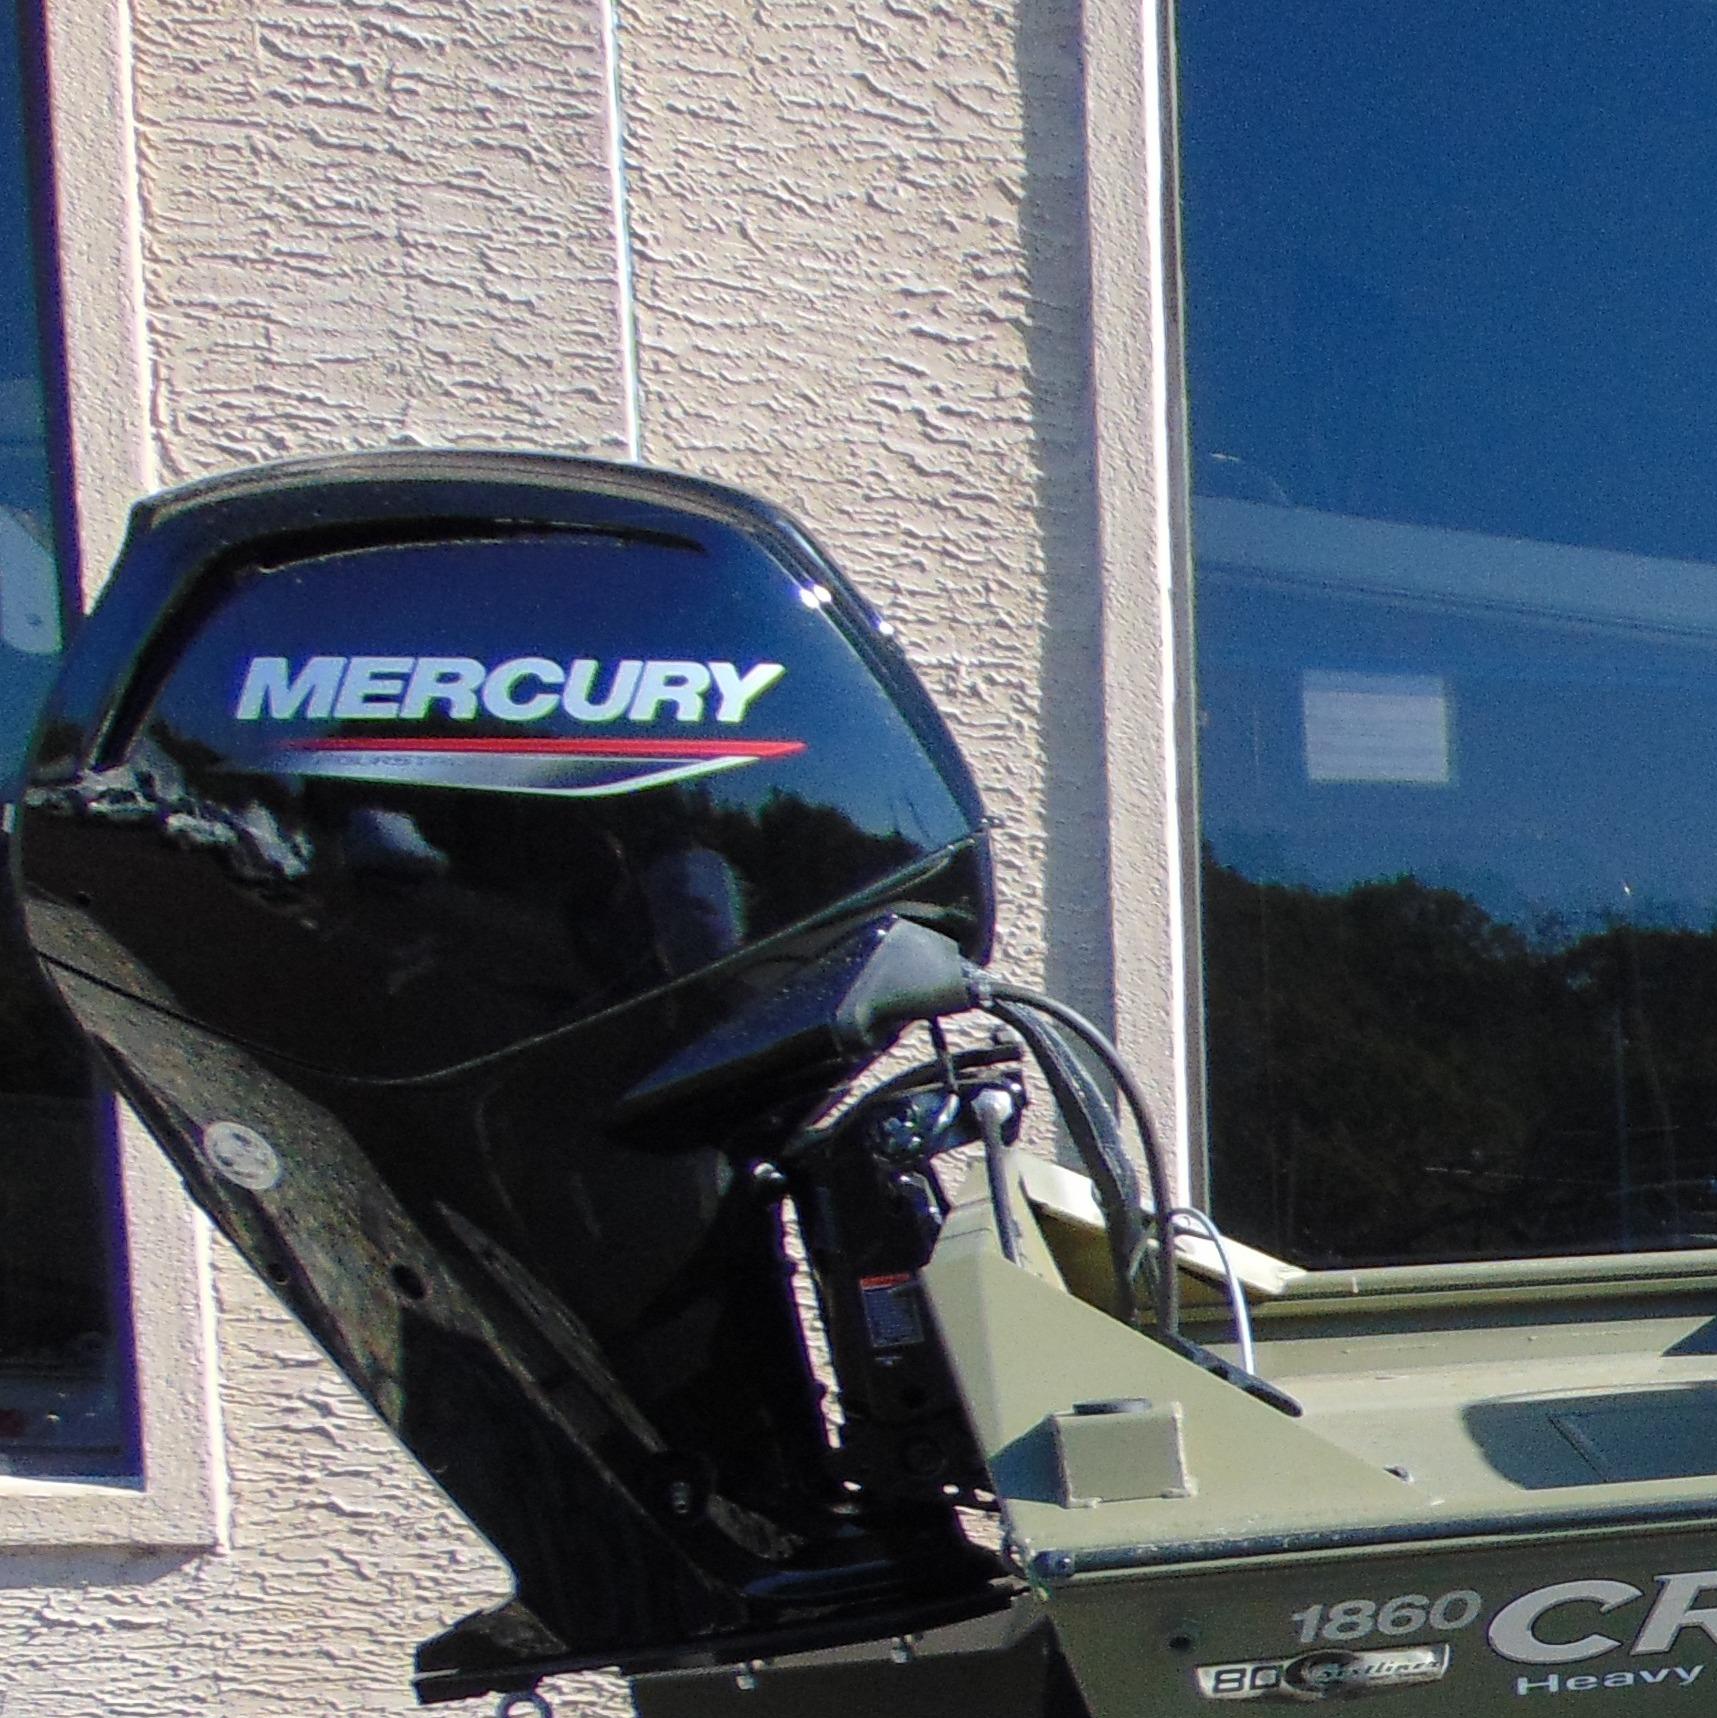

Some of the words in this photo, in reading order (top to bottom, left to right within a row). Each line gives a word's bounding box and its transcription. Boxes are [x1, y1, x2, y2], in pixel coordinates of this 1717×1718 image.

[236, 655, 787, 724] MERCURY
[1291, 1589, 1485, 1644] 1860
[1516, 1658, 1704, 1696] Heavy
